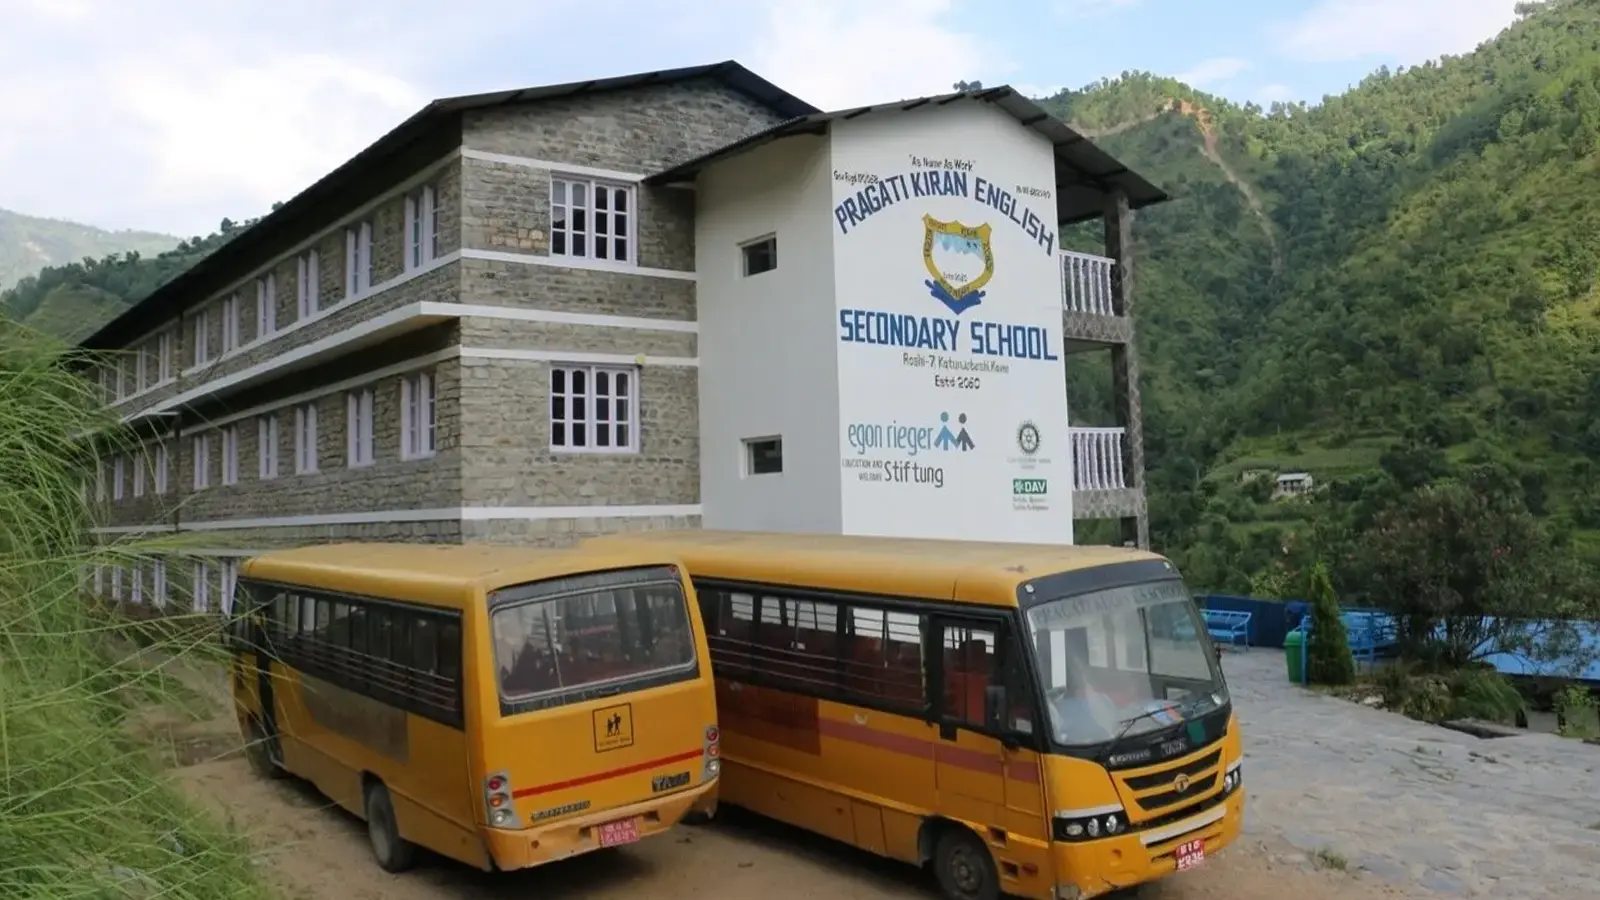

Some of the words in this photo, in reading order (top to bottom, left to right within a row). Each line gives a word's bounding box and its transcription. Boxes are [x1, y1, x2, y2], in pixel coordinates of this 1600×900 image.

[835, 174, 909, 234] PRAGATI
[910, 170, 968, 198] KIRAN
[975, 176, 1054, 257] ENGLISH
[840, 309, 960, 351] SECONDARY
[971, 321, 1058, 361] SCHOOL
[957, 376, 980, 390] 2060
[848, 423, 882, 455] egon
[887, 420, 933, 456] rieger
[884, 460, 944, 488] Stiftung
[1025, 481, 1045, 492] DAV
